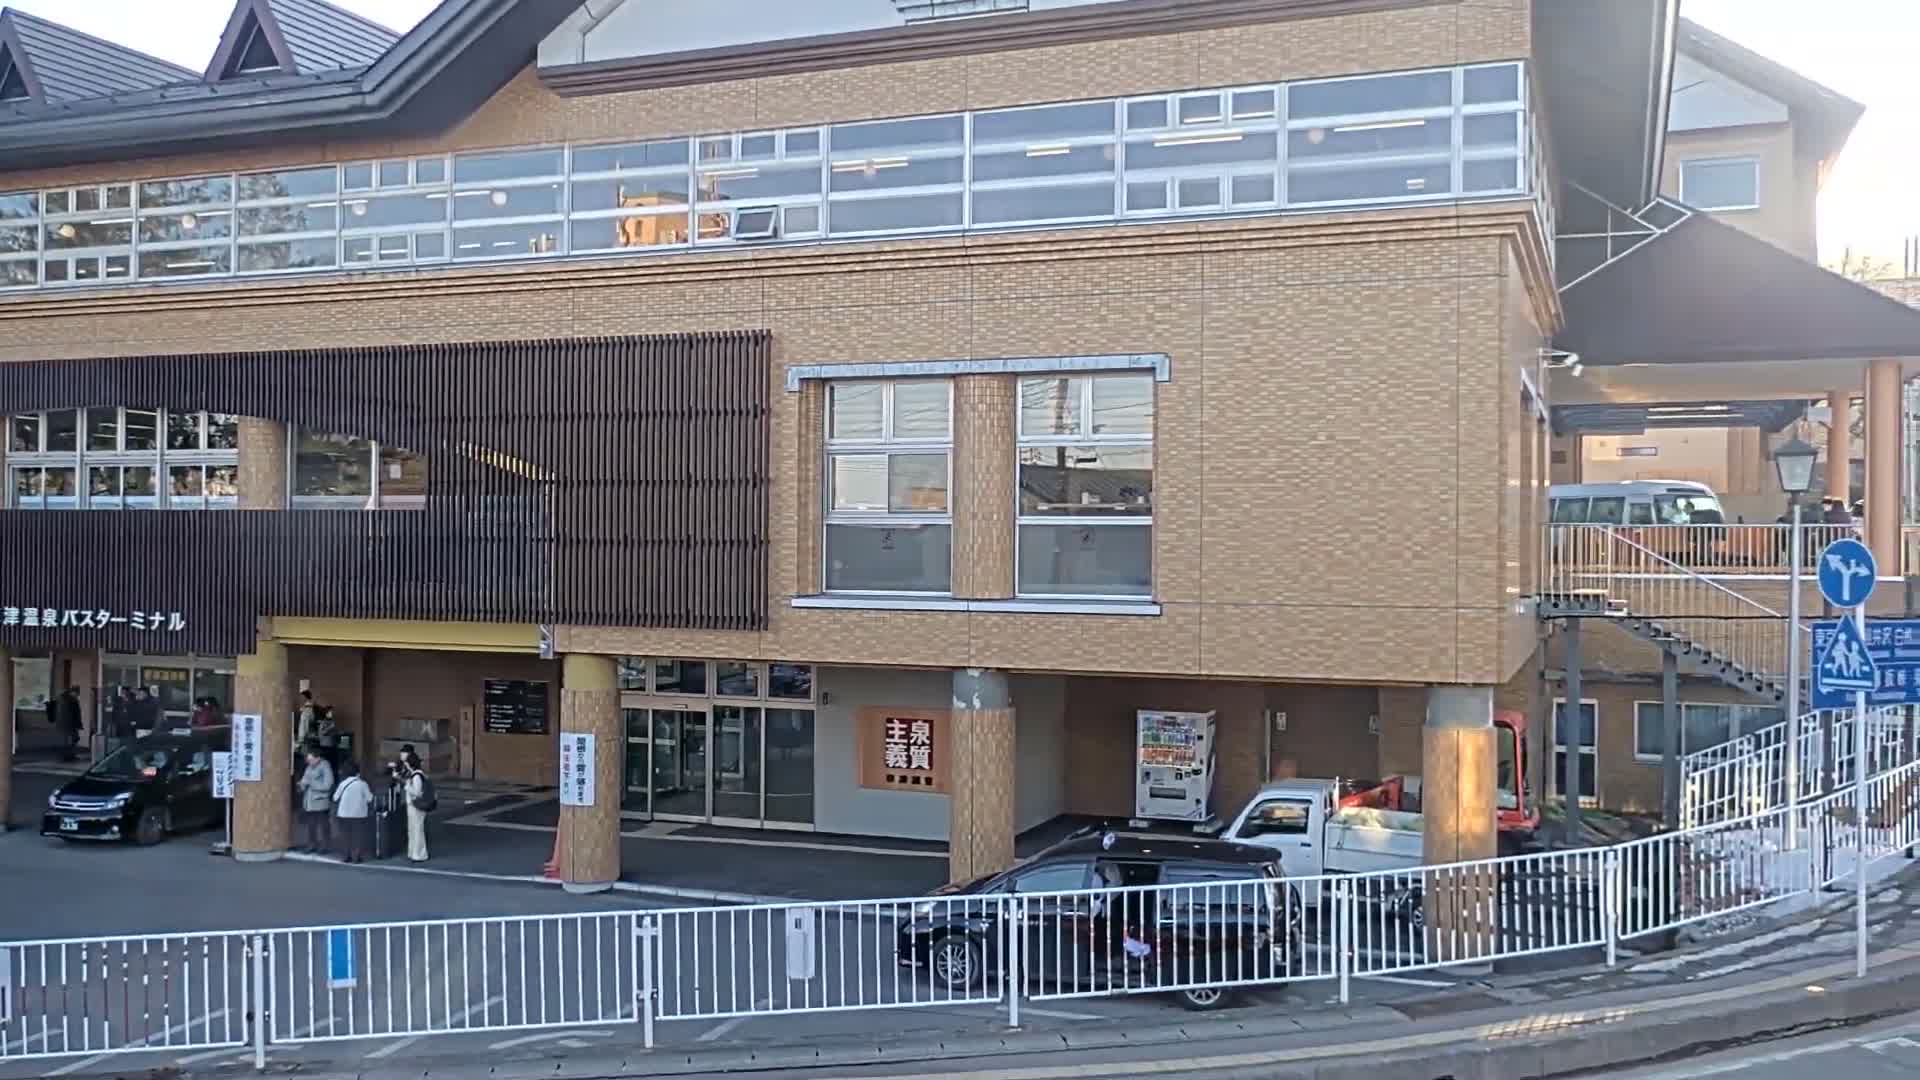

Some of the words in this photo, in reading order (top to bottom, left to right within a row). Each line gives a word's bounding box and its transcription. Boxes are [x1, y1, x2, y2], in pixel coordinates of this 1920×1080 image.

[0, 606, 187, 632] 津温泉バスターミナル
[885, 720, 908, 769] 主義
[910, 720, 931, 770] 泉質
